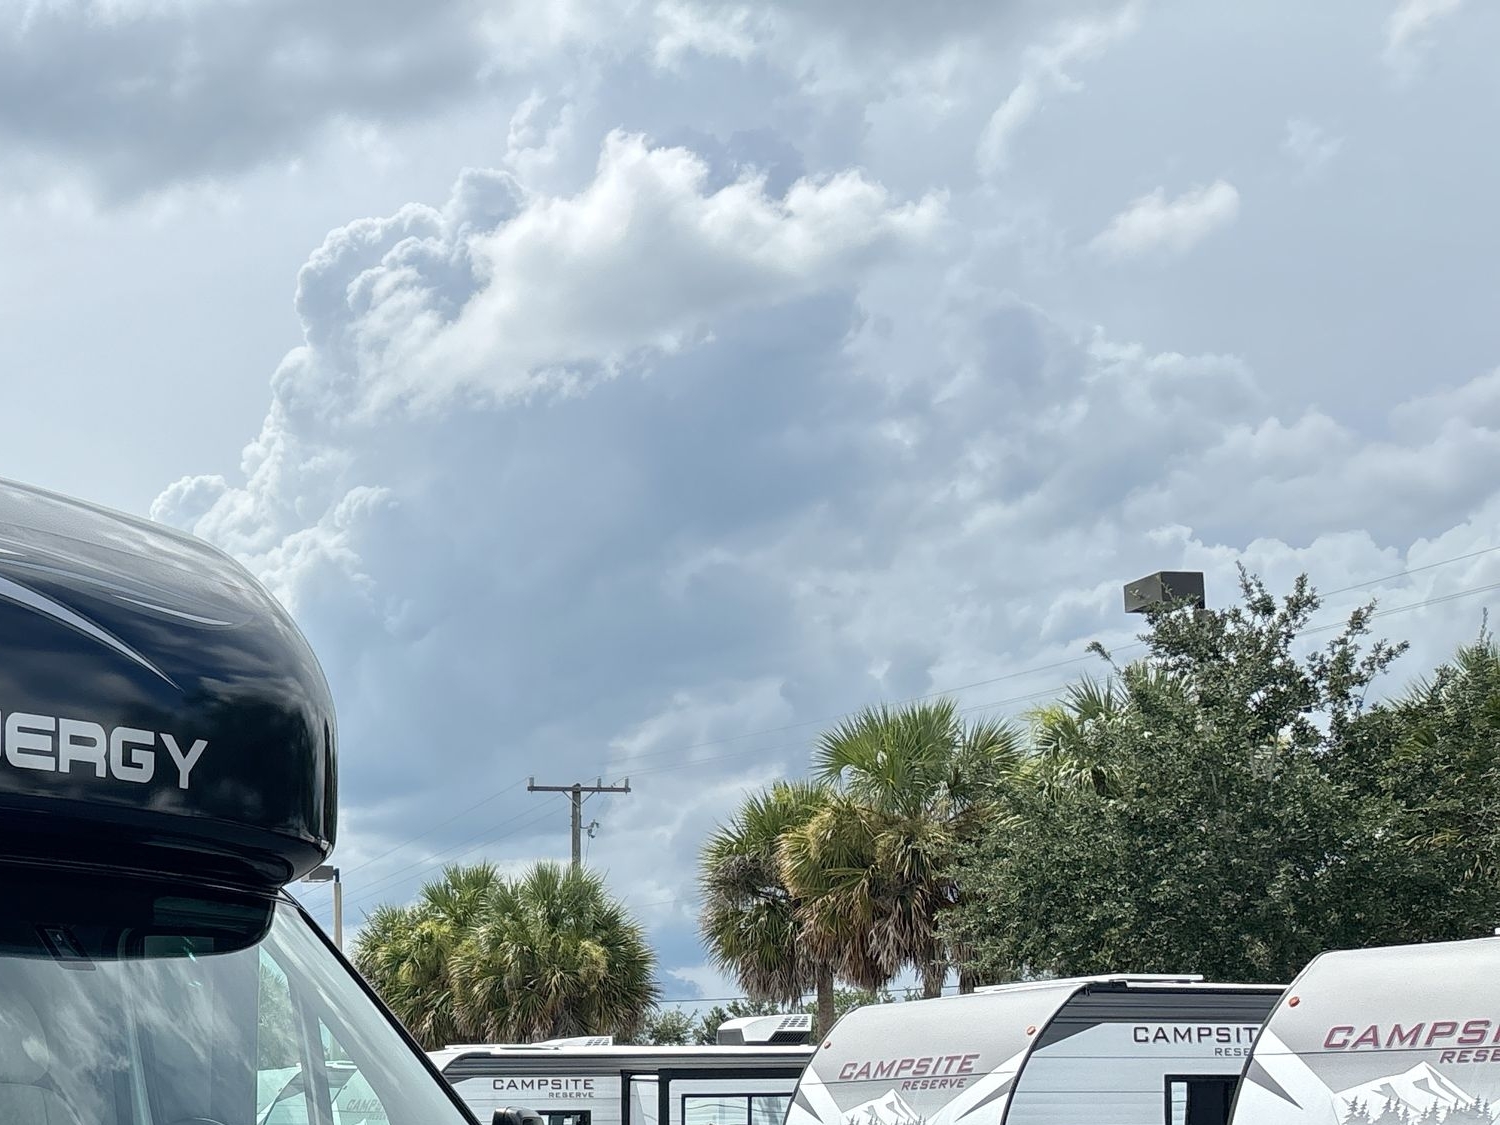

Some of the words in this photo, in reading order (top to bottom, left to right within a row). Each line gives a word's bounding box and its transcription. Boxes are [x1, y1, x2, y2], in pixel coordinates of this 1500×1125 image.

[1133, 1026, 1259, 1044] CAMPSIT
[1323, 1019, 1500, 1049] CAMPSI
[1214, 1047, 1251, 1056] RESE
[1439, 1049, 1500, 1064] RESE
[838, 1053, 981, 1081] CAMPSITE
[492, 1078, 595, 1091] CAMPSITE
[901, 1077, 968, 1091] RESERVE
[548, 1091, 595, 1099] RESERVE
